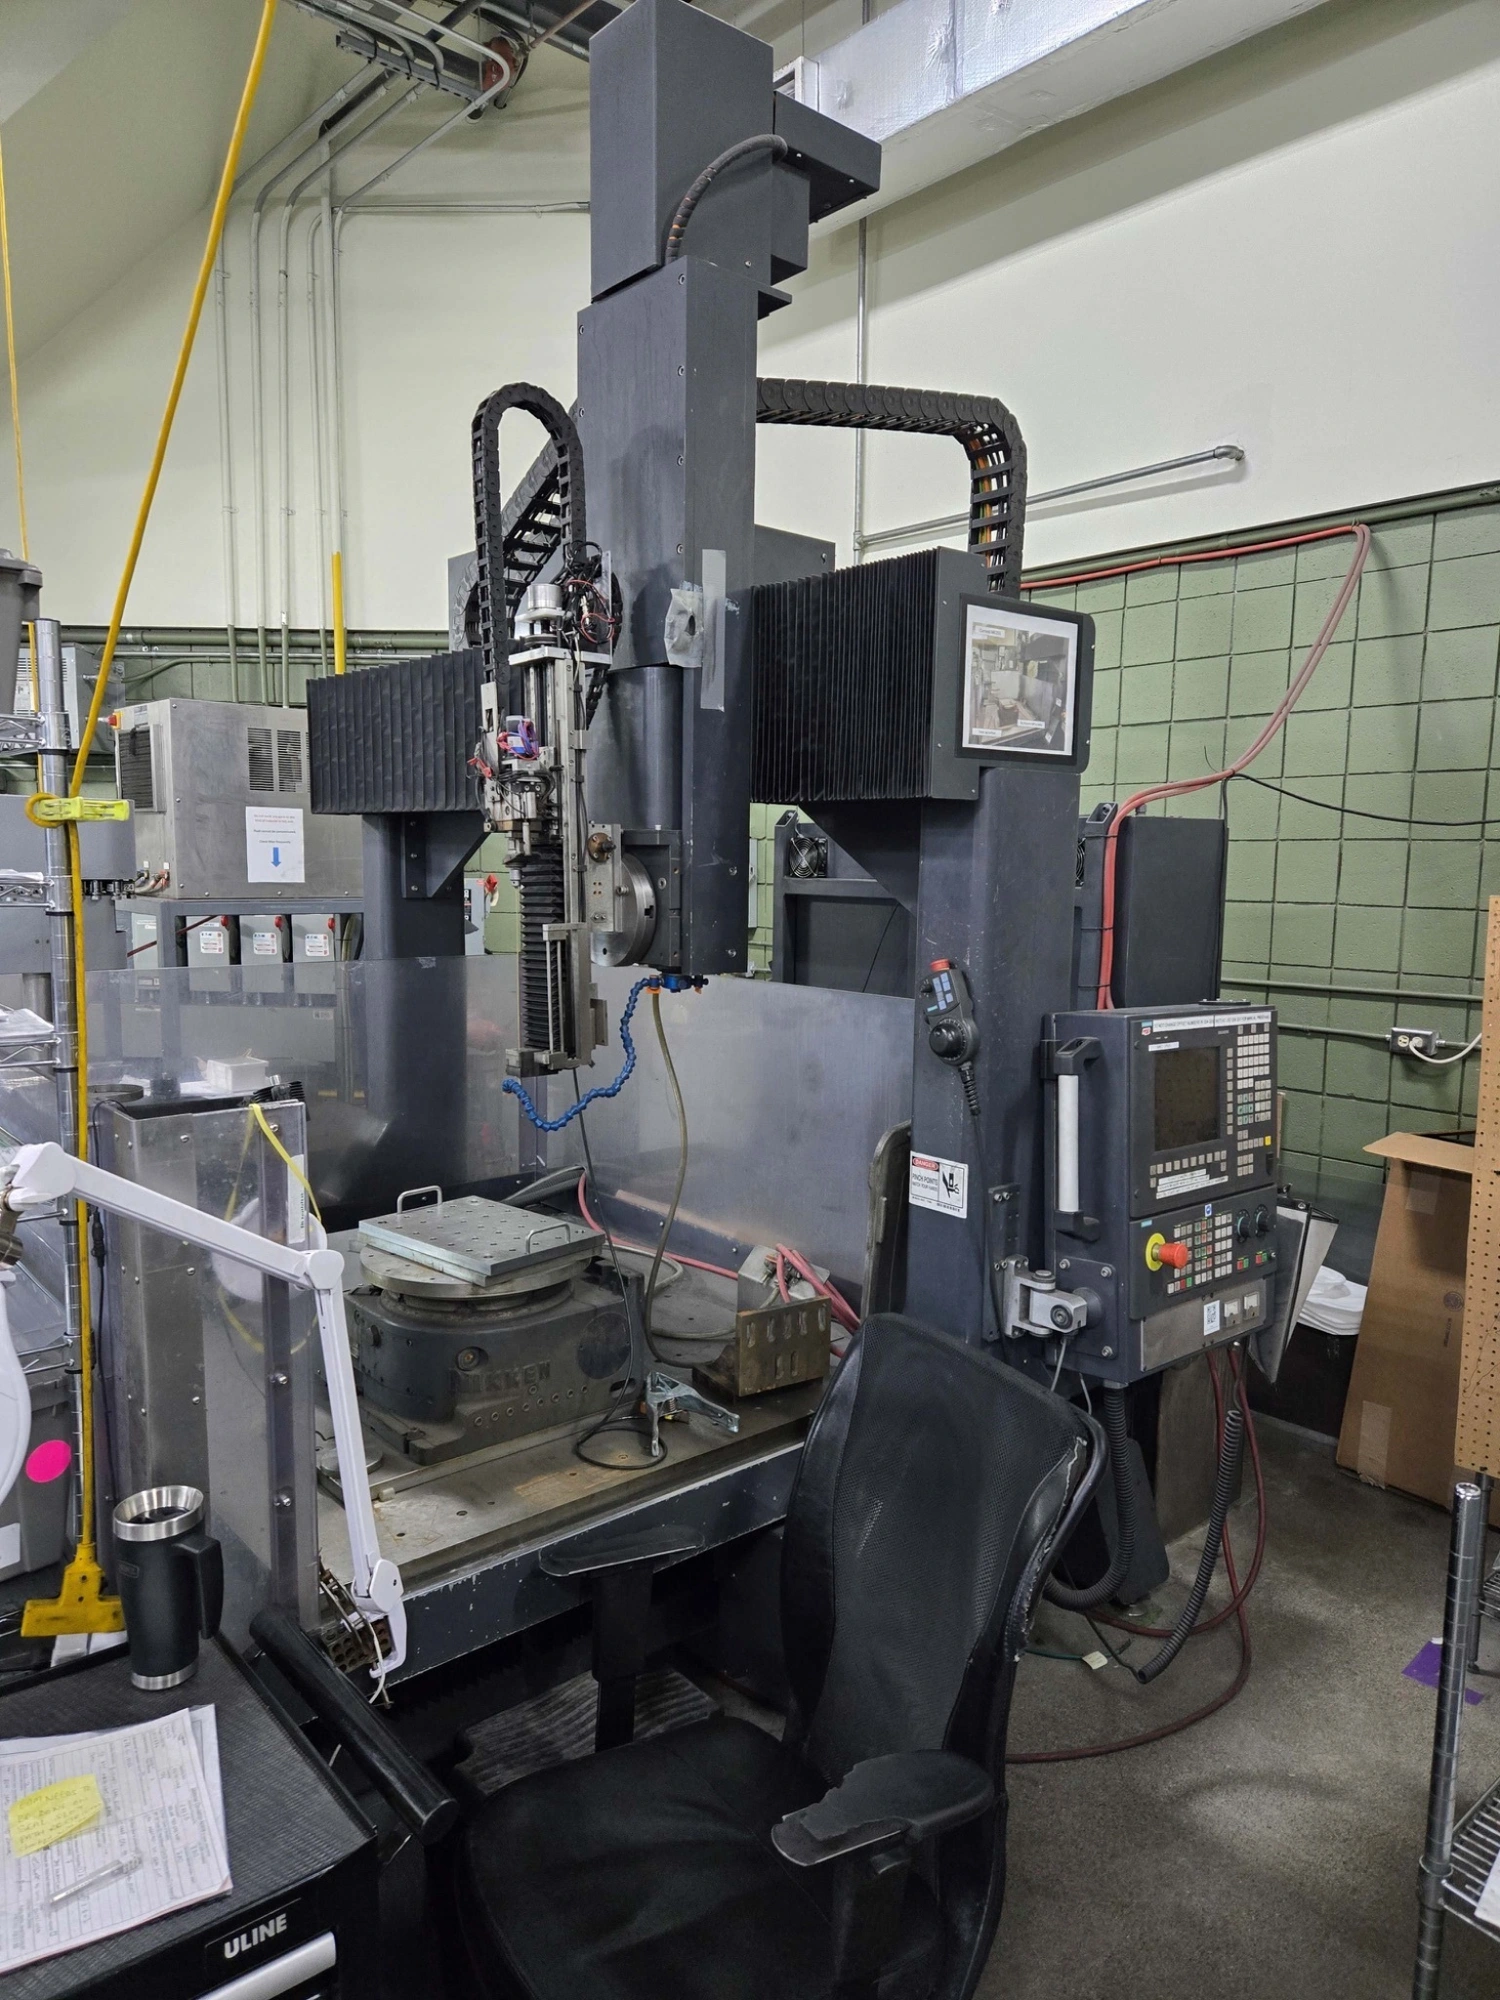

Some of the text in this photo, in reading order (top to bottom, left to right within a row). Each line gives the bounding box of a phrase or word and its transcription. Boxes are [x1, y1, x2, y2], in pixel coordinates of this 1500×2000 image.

[915, 1158, 936, 1168] DANGER
[912, 1173, 924, 1183] PINCH
[224, 1913, 287, 1959] ULINE
